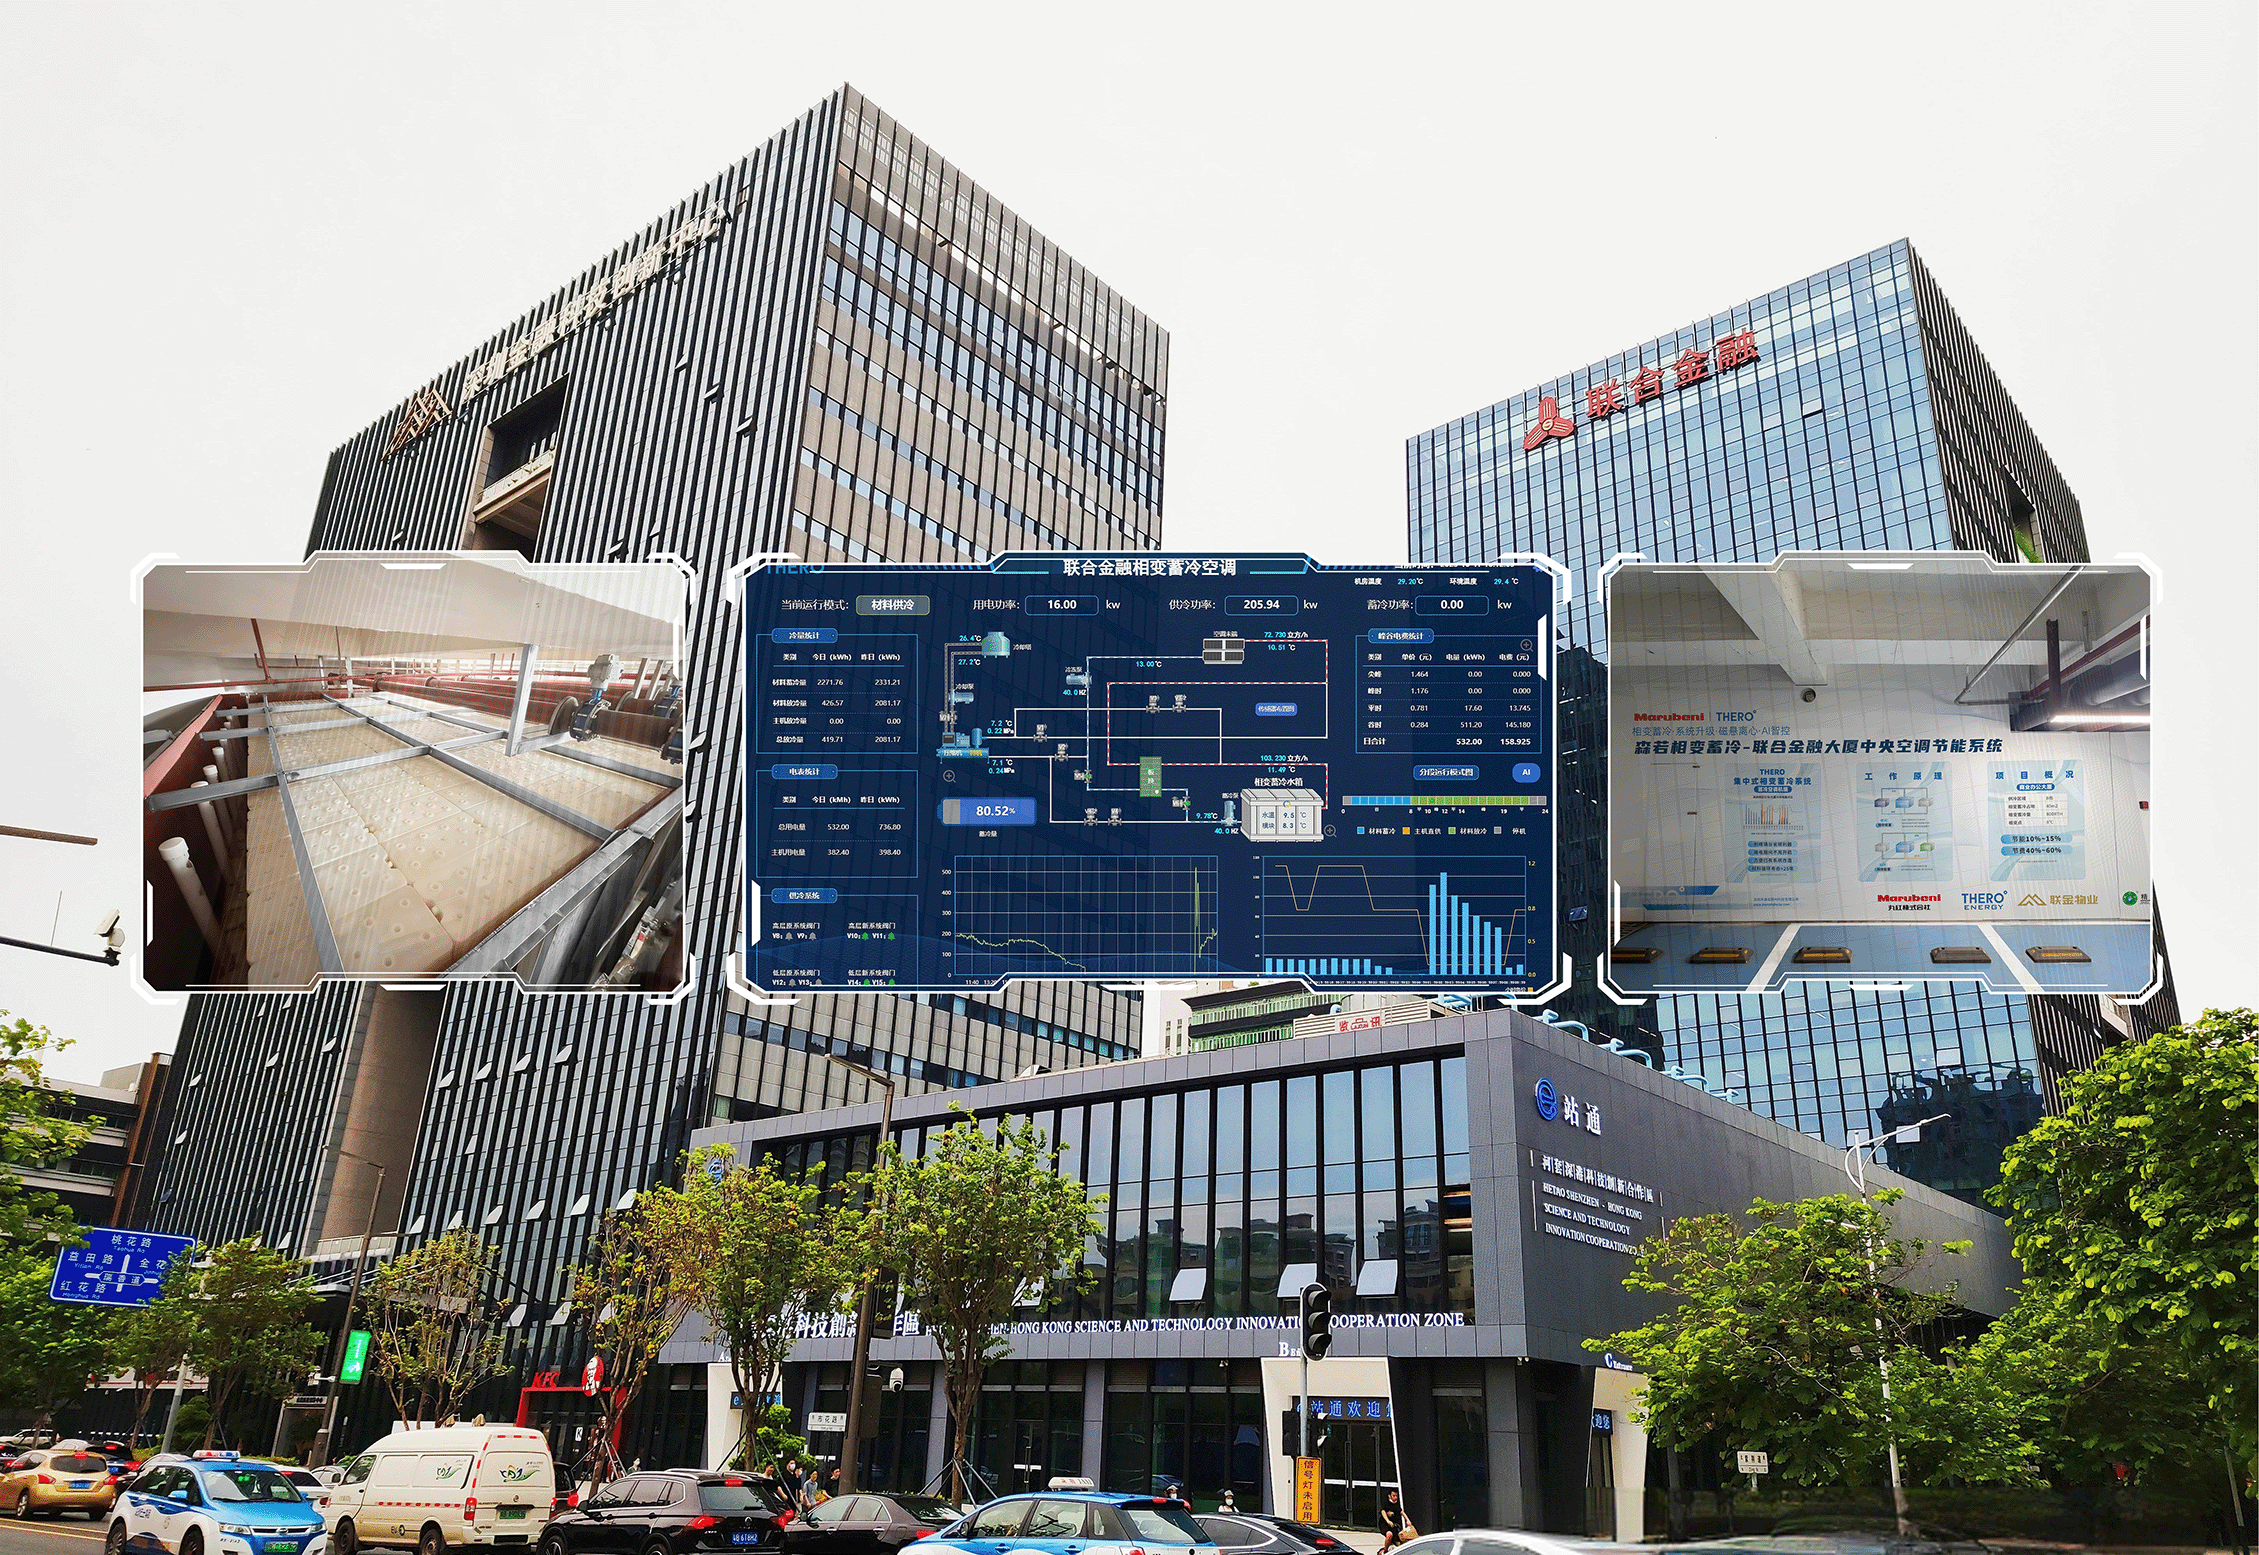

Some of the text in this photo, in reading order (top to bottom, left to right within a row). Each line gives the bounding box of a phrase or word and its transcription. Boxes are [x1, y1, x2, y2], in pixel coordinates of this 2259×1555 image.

[1585, 328, 1759, 418] 联合金融
[1634, 713, 1704, 721] Marubeni
[1634, 738, 2003, 755] 森若相变蓄冷-联合金融大厦中央空调节能系统
[1877, 894, 1942, 903] Marubeni
[2050, 895, 2099, 905] 联金物业
[1542, 1182, 1643, 1221] HETAO SHENZHEN HONG KONG
[1543, 1202, 1631, 1236] SCIENCE AND TECHNOLOGY
[111, 1234, 152, 1248] 桃花路
[1545, 1222, 1628, 1254] INNOVATION COOPERATION
[68, 1251, 113, 1265] 益田路
[60, 1280, 107, 1294] 红花路
[1041, 1313, 1465, 1333] KONG SCIENCE AND TECHNOLOGY INNOVATI OOPERATION ZONE
[532, 1371, 561, 1388] KFC
[1302, 1460, 1314, 1520] 信号灯未启用
